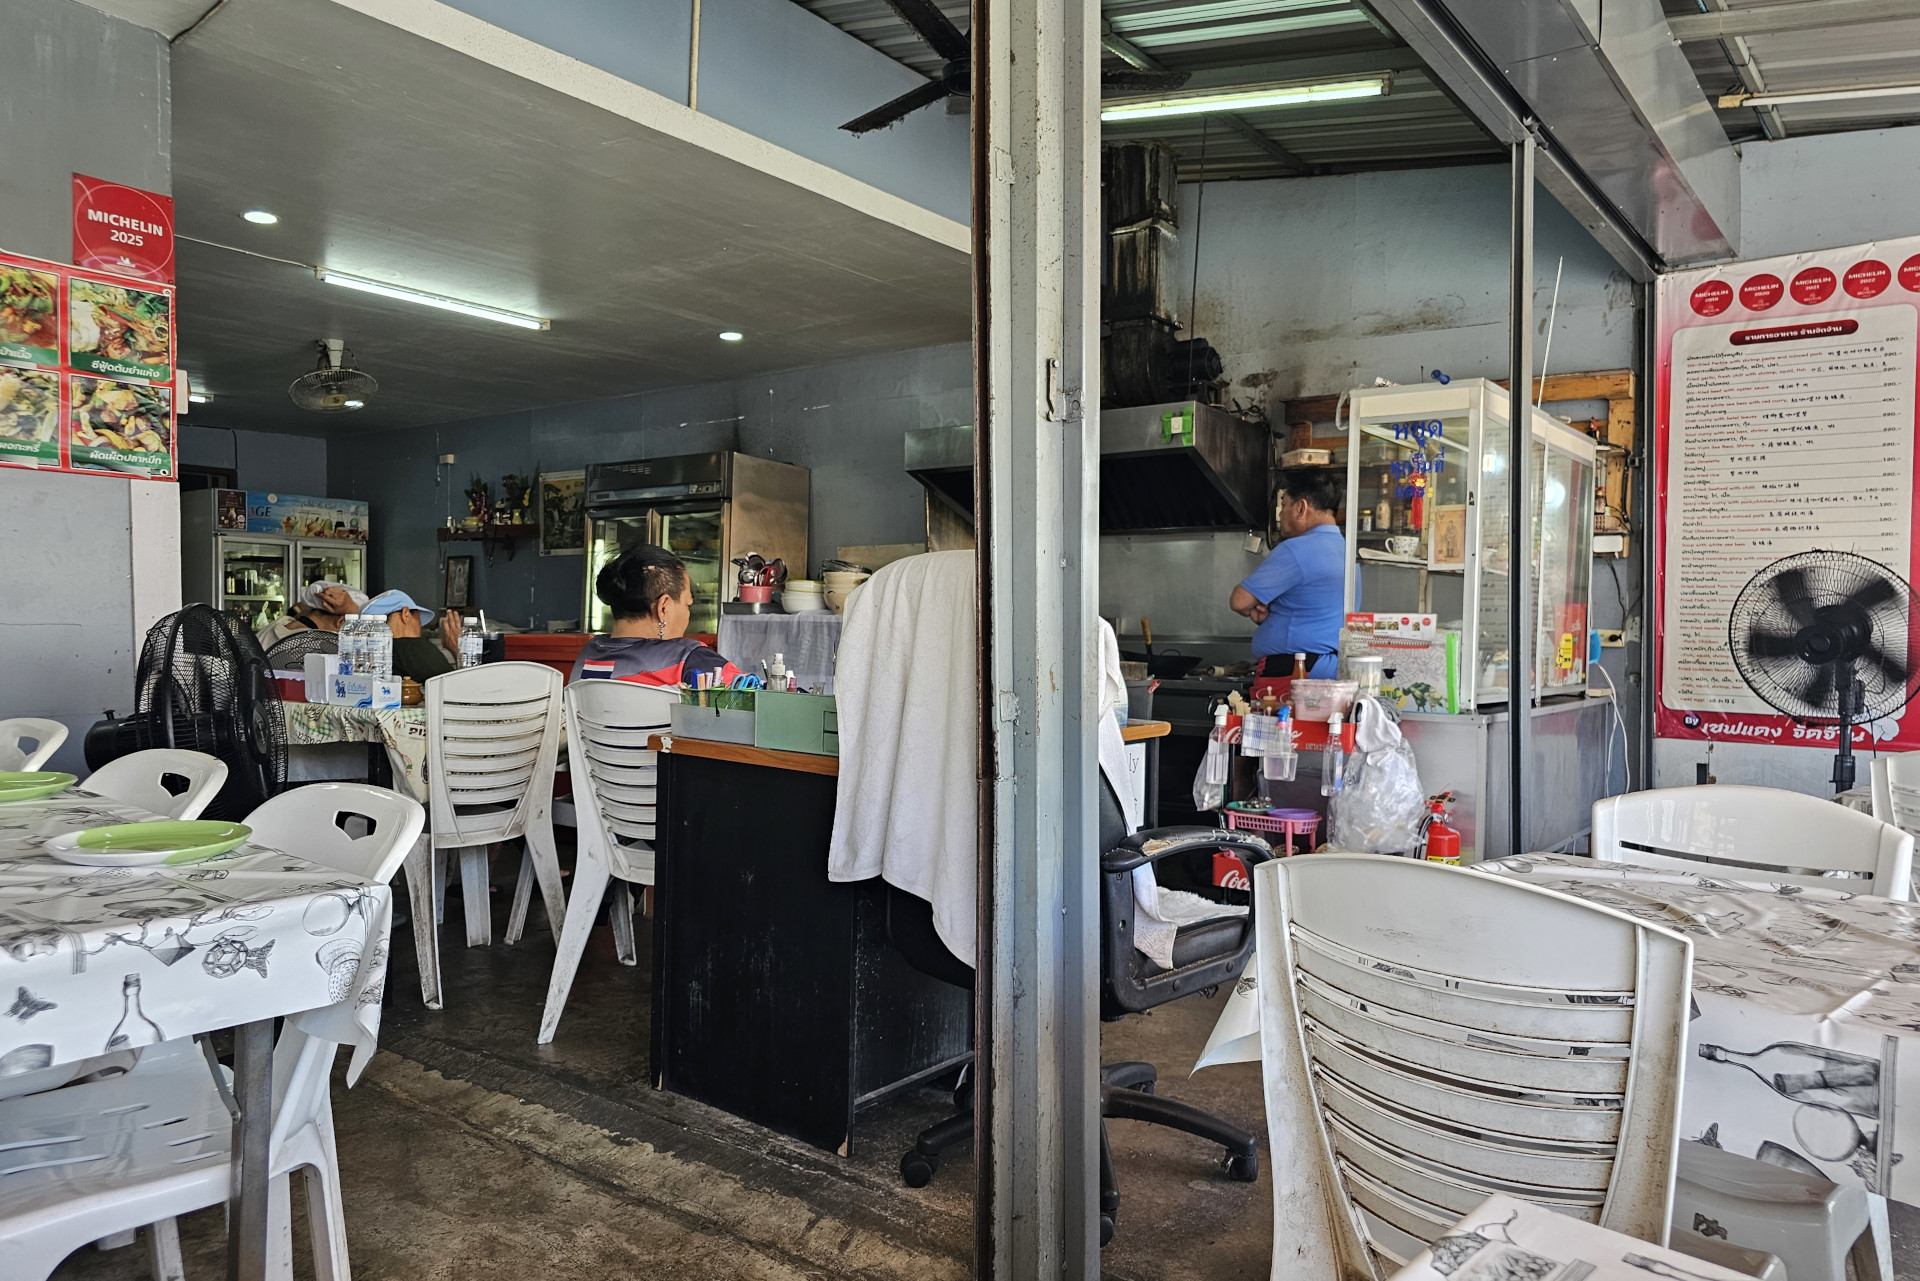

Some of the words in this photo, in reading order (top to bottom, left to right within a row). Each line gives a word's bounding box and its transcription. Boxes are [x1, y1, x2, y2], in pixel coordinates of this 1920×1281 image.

[87, 208, 163, 237] MICHELIN
[110, 229, 144, 247] 2025
[1849, 270, 1886, 279] MICHELIN
[1795, 277, 1831, 286] MICHELIN
[1744, 283, 1779, 292] MICHELIN
[1694, 290, 1729, 298] MICHELIN
[1392, 420, 1443, 448] หยุด
[1685, 717, 1699, 727] By
